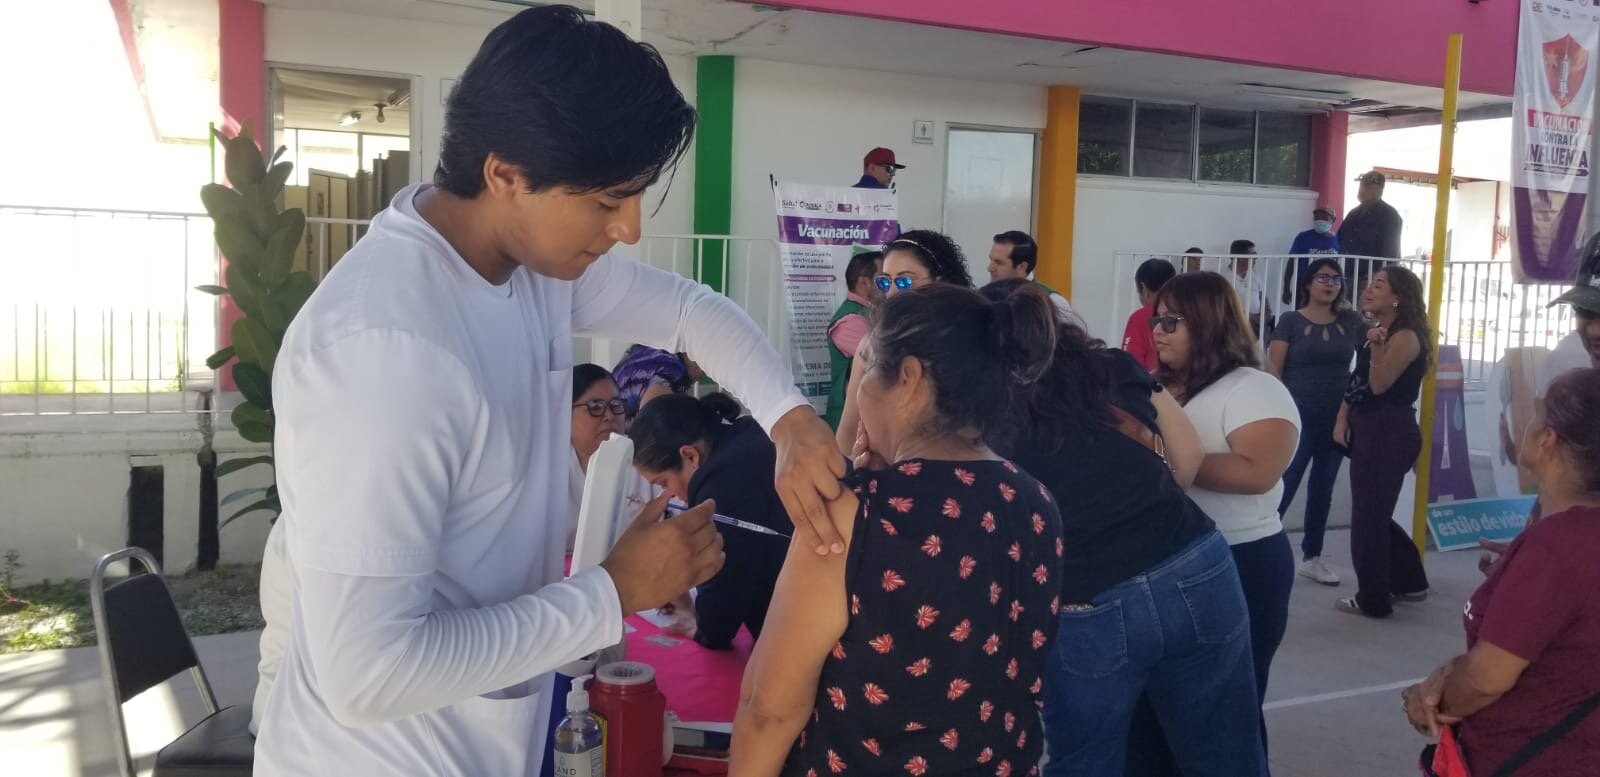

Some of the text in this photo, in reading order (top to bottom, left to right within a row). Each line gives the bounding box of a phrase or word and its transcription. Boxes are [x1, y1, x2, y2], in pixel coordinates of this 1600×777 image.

[798, 223, 869, 239] Vacunación
[1432, 509, 1441, 518] de
[1438, 515, 1481, 536] estilo
[1481, 513, 1500, 530] de
[555, 766, 577, 776] AND
